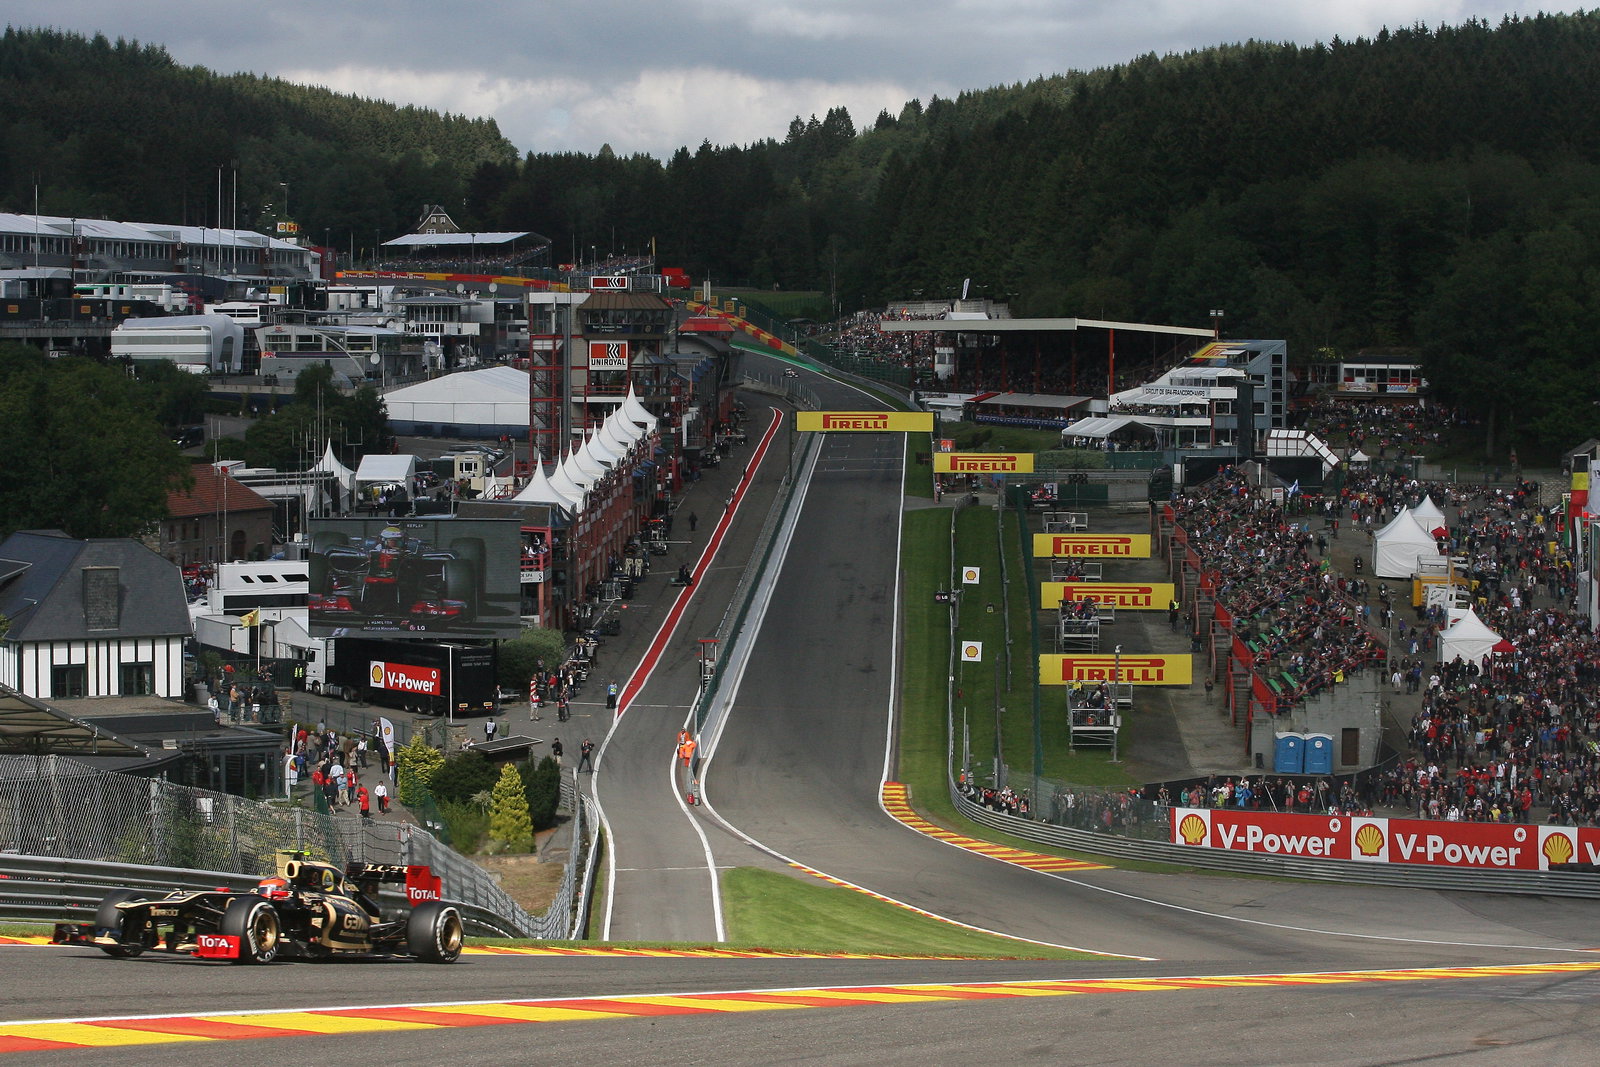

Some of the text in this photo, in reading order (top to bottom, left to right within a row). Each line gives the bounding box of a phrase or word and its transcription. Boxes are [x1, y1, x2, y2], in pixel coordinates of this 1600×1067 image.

[823, 414, 888, 429] PIRELLI
[950, 456, 1017, 471] PIRELLI
[1053, 537, 1132, 555] PIRELLI
[1062, 658, 1165, 681] PIRELLI
[387, 671, 435, 692] V-Power
[1216, 823, 1336, 855] V-Power
[1395, 833, 1521, 866] V-Power
[409, 887, 440, 900] TOTAL
[199, 935, 234, 949] TOTA
